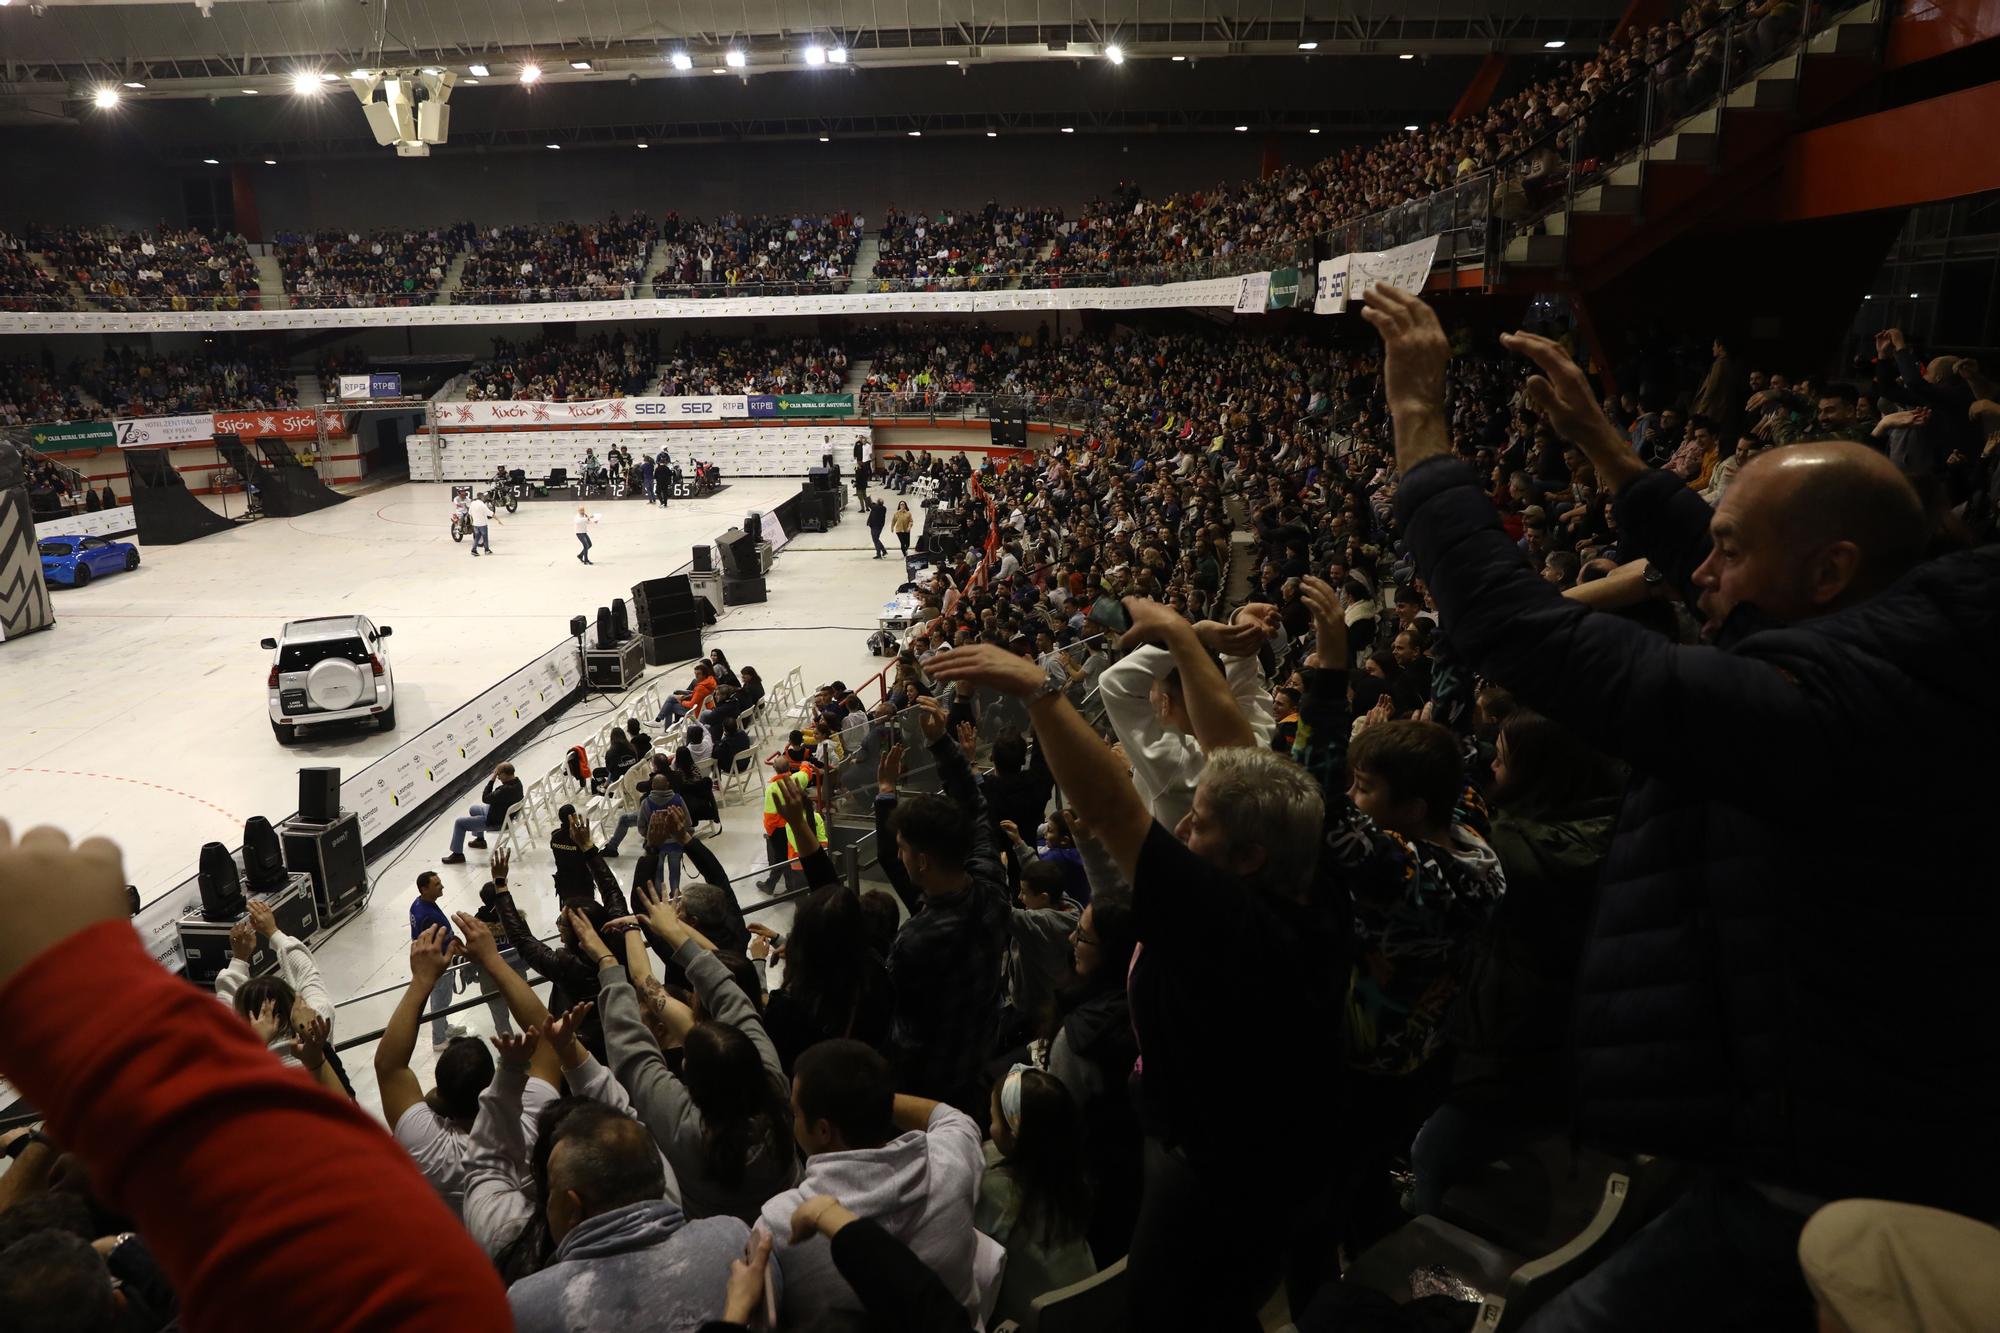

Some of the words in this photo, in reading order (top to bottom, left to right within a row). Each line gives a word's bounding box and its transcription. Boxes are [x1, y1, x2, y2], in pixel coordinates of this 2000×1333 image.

[492, 404, 528, 419] Xixón
[568, 404, 605, 418] Xixón
[635, 403, 666, 414] SER
[681, 402, 712, 413] SER
[163, 419, 194, 427] ZENTRAL
[216, 418, 254, 434] gijón
[86, 431, 113, 439] ASTURIAS
[611, 484, 625, 497] 72
[674, 483, 690, 496] 65
